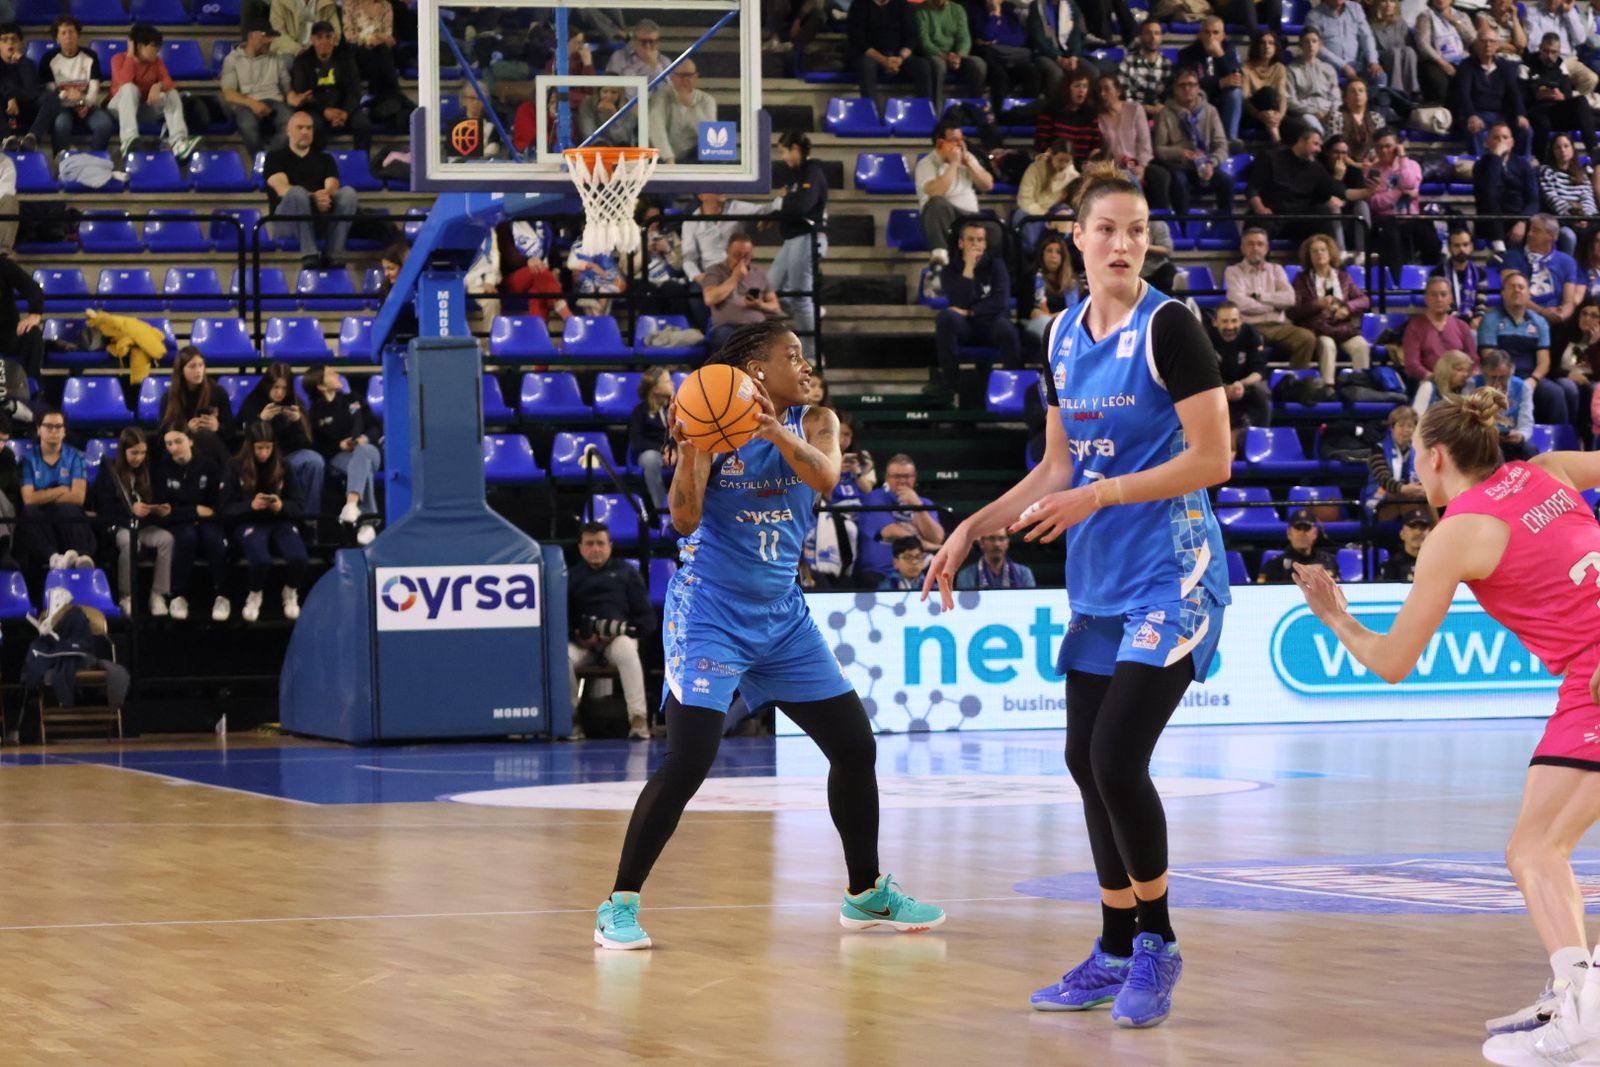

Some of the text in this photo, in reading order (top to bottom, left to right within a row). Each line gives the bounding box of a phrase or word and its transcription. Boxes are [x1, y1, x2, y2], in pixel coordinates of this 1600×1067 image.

[437, 290, 449, 337] MONDO
[1102, 393, 1136, 408] LEÓN
[719, 479, 771, 490] CASTILLA
[758, 530, 780, 562] 11
[493, 707, 539, 719] MONDO
